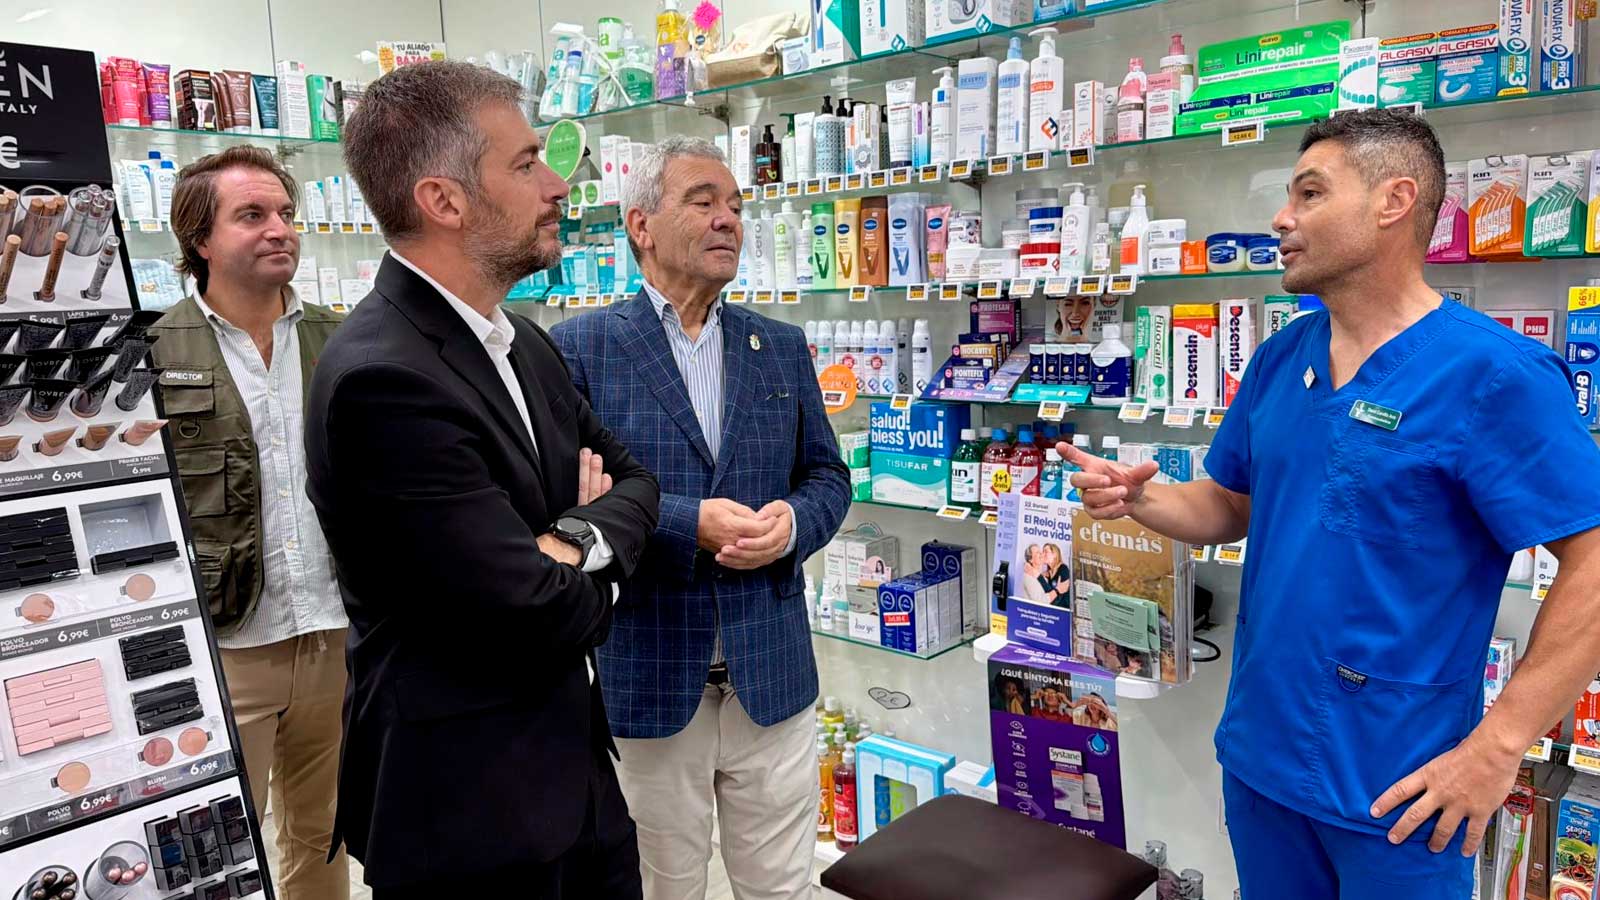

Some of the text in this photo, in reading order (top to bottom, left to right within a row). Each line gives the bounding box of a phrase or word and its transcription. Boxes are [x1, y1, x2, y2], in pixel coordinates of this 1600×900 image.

[406, 43, 430, 51] ALIADO
[1439, 37, 1496, 52] ALGASIV
[1235, 41, 1306, 66] Linirepair
[1381, 46, 1435, 60] ALGASIV
[1508, 55, 1527, 86] PRO 3
[1551, 61, 1571, 90] PRO 3
[1259, 89, 1291, 100] Linirepair
[1182, 100, 1212, 110] Linirepair
[1229, 105, 1269, 117] Linirepair
[1525, 325, 1546, 334] PHB
[1155, 314, 1164, 368] Fluocaril
[1230, 305, 1244, 372] Desensin
[1184, 334, 1198, 398] Desensin
[166, 372, 203, 381] DIRECTOR
[871, 409, 911, 430] salud!
[871, 421, 944, 450] bless you!
[118, 457, 139, 465] PRIMER
[886, 459, 928, 471] TISUFAR
[4, 470, 84, 484] MAQUILLAJE 6,99€
[993, 473, 1009, 483] 1+1
[1024, 515, 1032, 525] El
[1033, 515, 1057, 531] Reloj
[1023, 525, 1072, 542] salva vida
[1079, 521, 1163, 554] efemás
[110, 608, 190, 624] POLVO 6,99€
[110, 615, 154, 630] BRONCEADOR
[0, 630, 90, 646] POLVO 6,99€
[1, 638, 49, 652] BRONCEADOR
[1000, 667, 1103, 692] ¿QUÉ SÍNTOMA ERES TÚ?
[1050, 748, 1082, 762] Systane
[147, 760, 219, 786] BLUSH 6,99€
[48, 796, 112, 817] POLVO 6,99€
[1565, 824, 1591, 836] Stages
